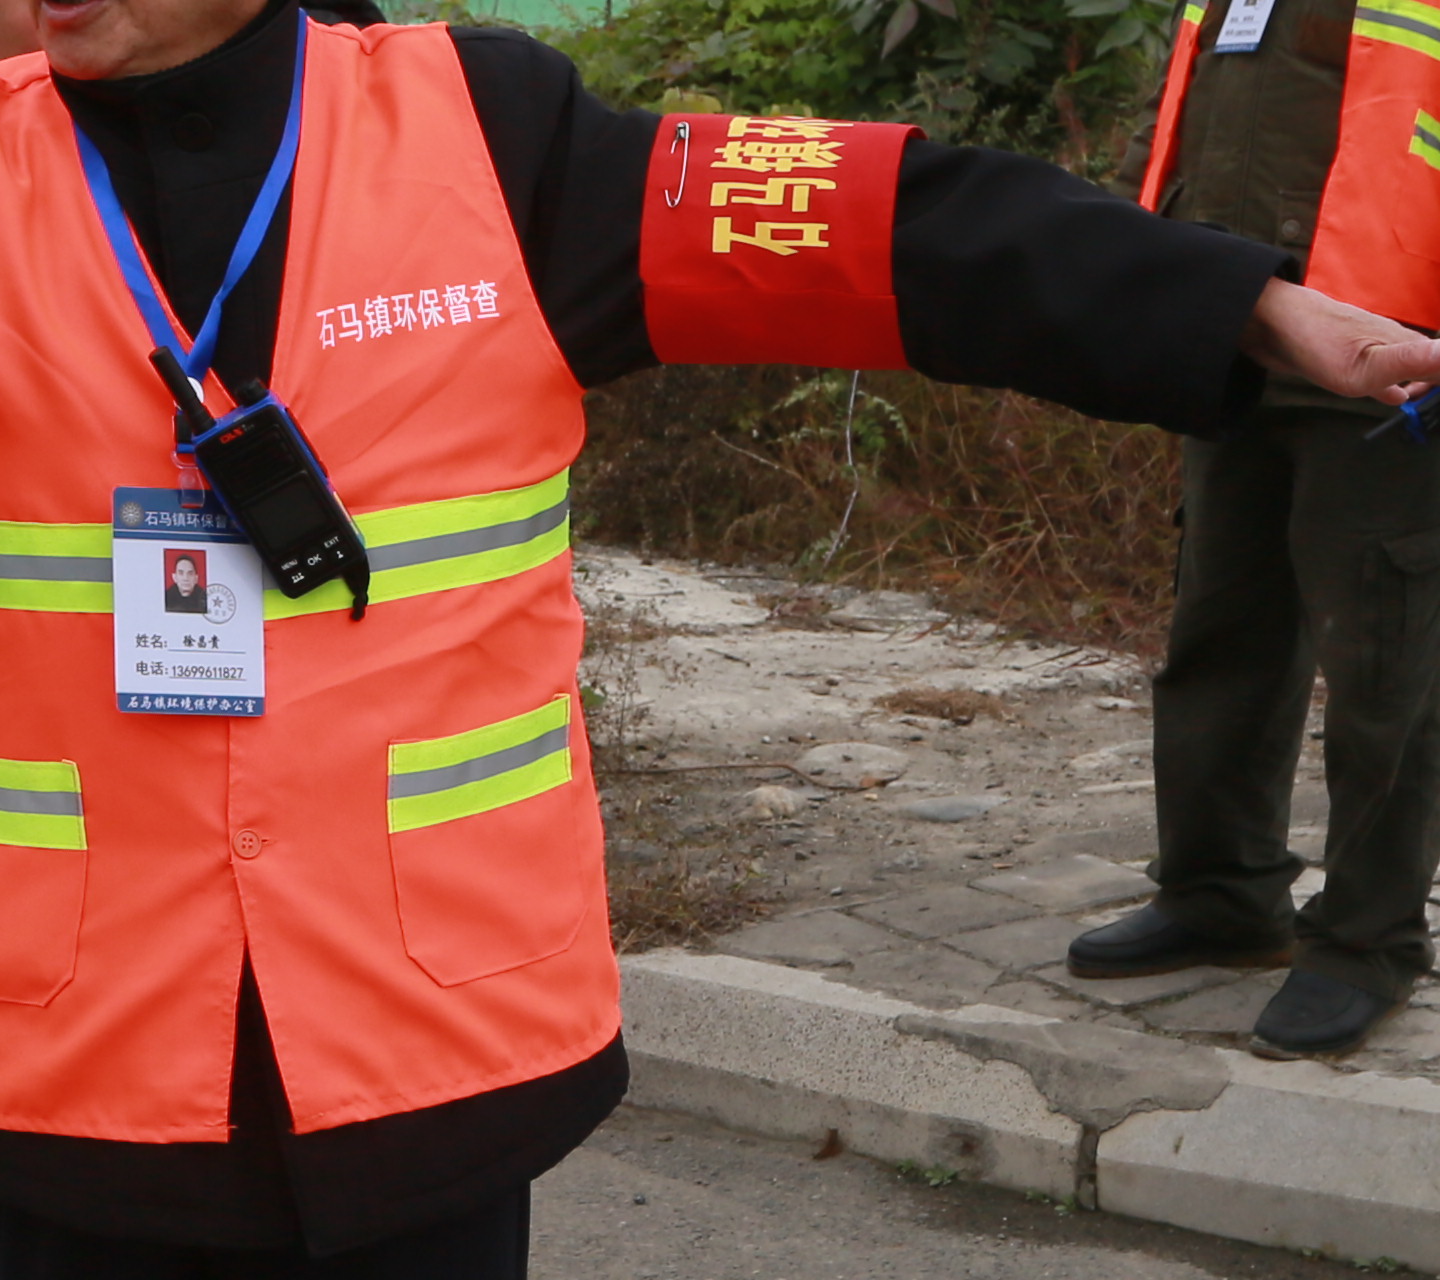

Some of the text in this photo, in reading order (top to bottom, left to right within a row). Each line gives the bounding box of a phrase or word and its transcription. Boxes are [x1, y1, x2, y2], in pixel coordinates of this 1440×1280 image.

[316, 279, 501, 350] 石马镇环保督查
[307, 554, 322, 566] OK
[324, 536, 340, 548] EXIT
[135, 633, 168, 649] 姓名:
[127, 695, 257, 713] 石马镇环境保护办公室
